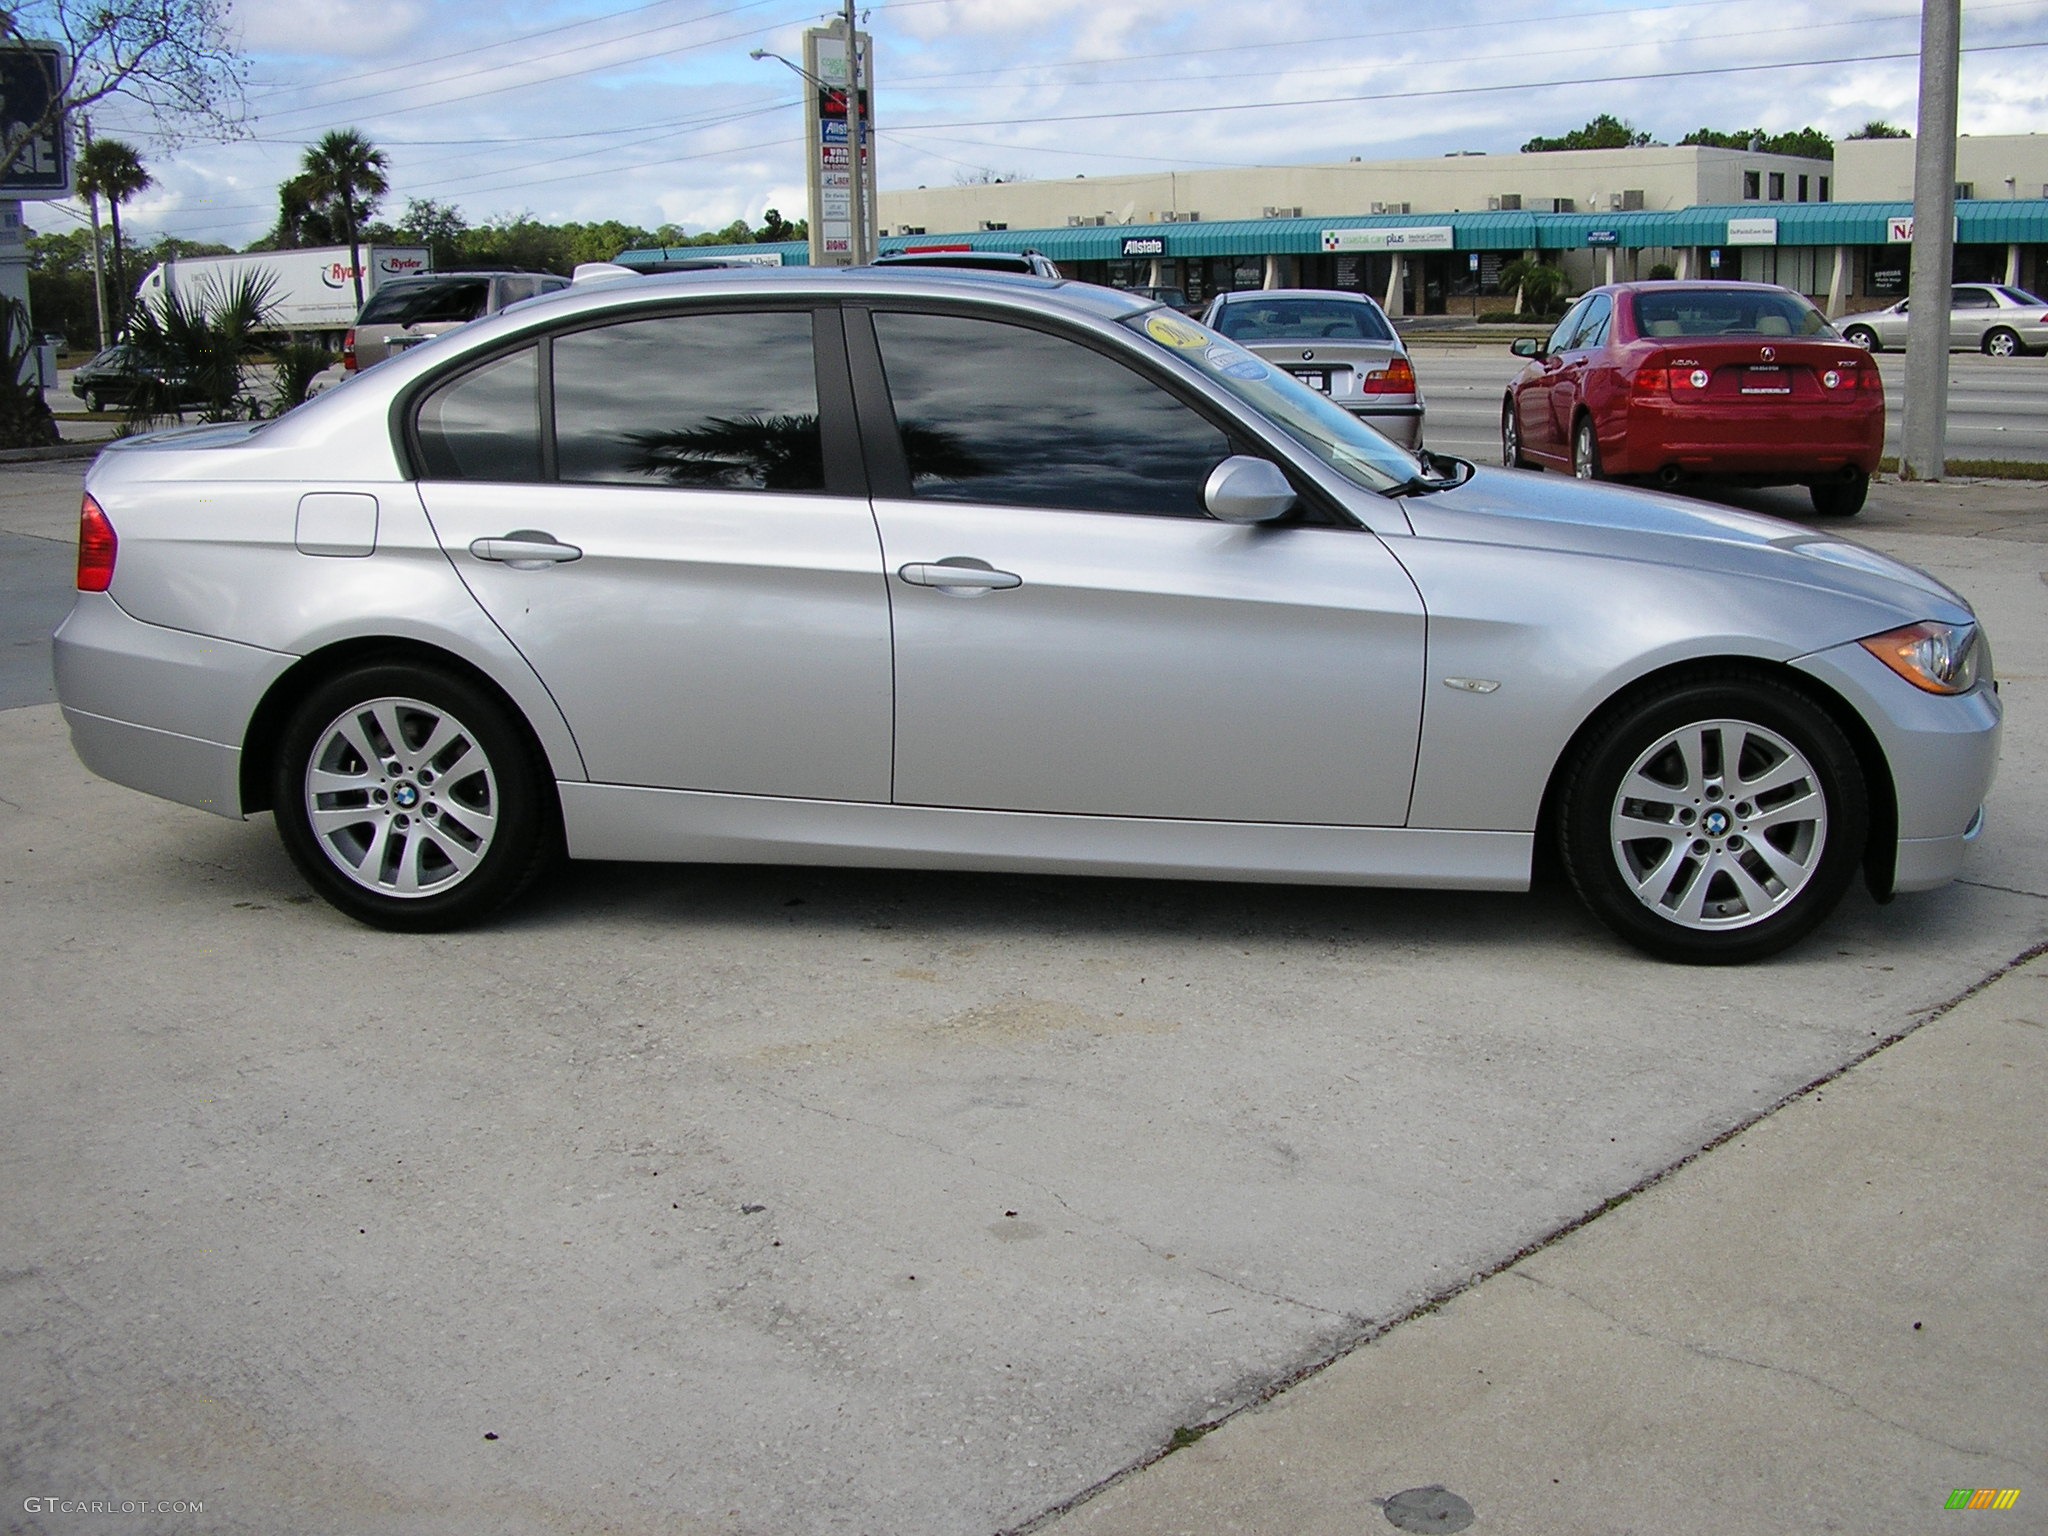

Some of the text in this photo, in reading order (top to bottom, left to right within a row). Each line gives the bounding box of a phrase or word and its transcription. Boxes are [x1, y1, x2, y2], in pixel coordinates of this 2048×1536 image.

[825, 121, 848, 134] Allst
[826, 240, 848, 251] SIGNS
[1386, 233, 1404, 247] plus
[1123, 239, 1162, 255] Allstate
[391, 258, 423, 271] Ryder
[332, 263, 367, 283] Rydr
[1671, 359, 1700, 367] ACURA
